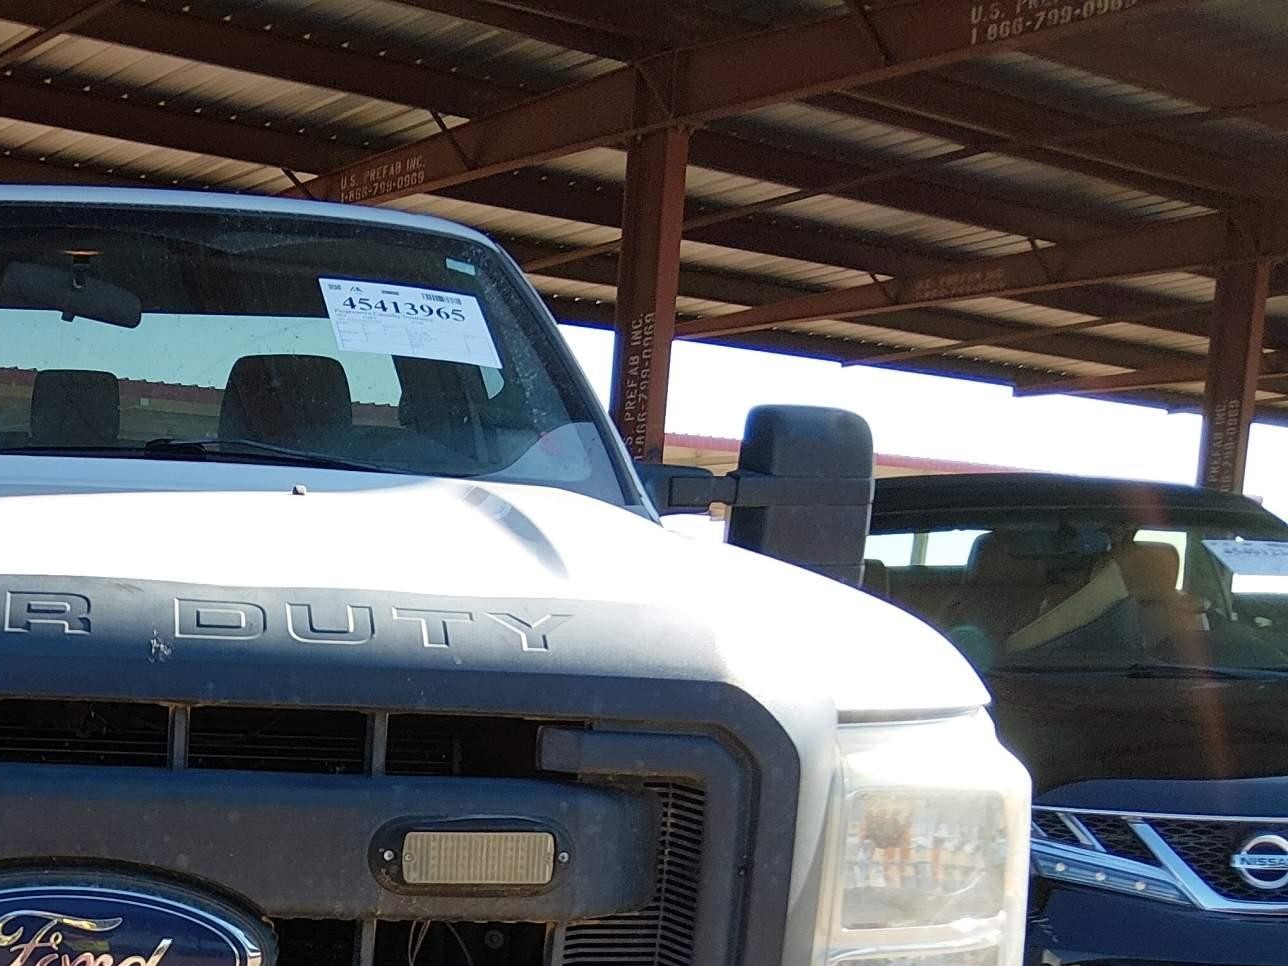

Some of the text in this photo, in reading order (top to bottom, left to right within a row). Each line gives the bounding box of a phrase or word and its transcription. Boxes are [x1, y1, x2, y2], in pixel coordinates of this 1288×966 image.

[363, 161, 402, 184] PREFAB
[406, 155, 426, 172] INC.
[342, 296, 466, 322] 45413965
[631, 313, 644, 346] INC.
[624, 355, 640, 421] PREFAB
[173, 597, 574, 653] DUTY
[1240, 856, 1288, 866] NISSA
